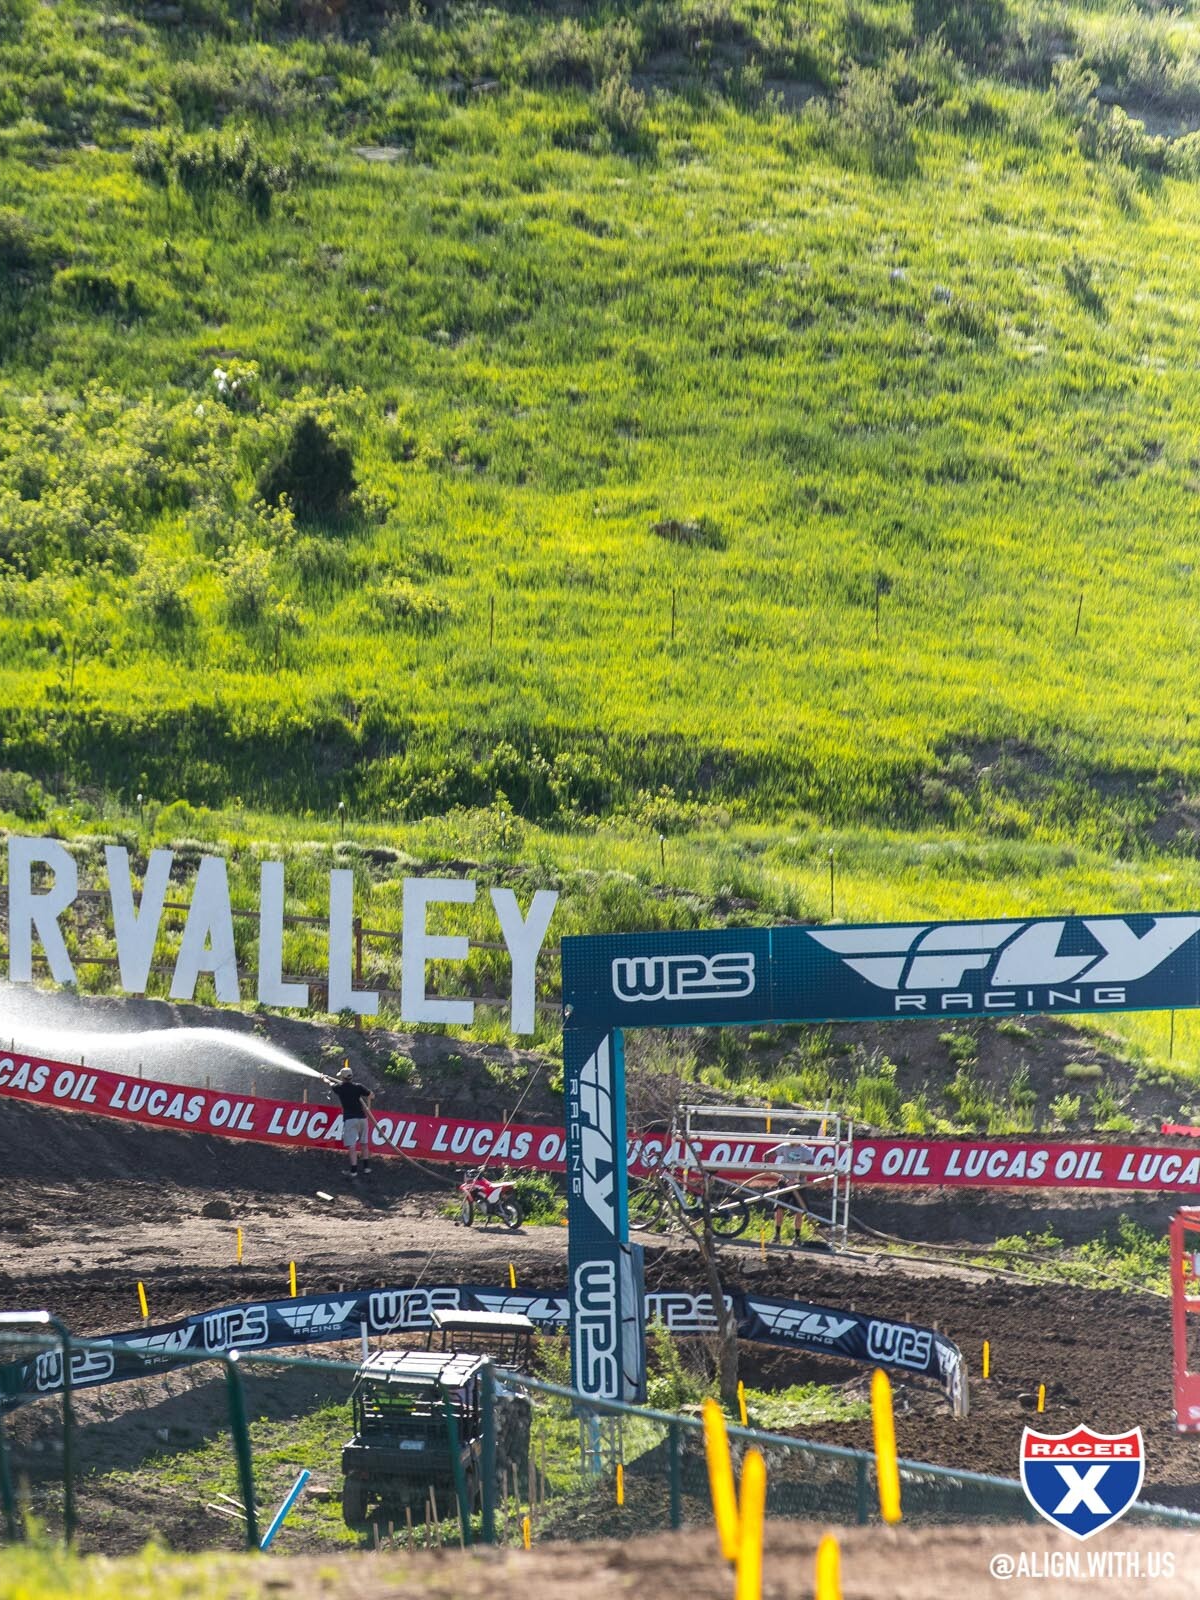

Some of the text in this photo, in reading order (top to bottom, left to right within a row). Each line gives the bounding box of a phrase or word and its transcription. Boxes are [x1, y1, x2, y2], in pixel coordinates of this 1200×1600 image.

[806, 917, 1200, 989] FLY
[612, 952, 755, 1002] WPS
[895, 987, 1127, 1011] RACING
[53, 1071, 98, 1103] OIL
[109, 1082, 255, 1130] LUCAS OIL
[267, 1107, 418, 1149] LUCA OIL
[432, 1124, 533, 1162] LUCAS
[569, 1078, 582, 1195] RACING
[580, 1033, 615, 1236] FLY
[881, 1147, 931, 1178] OIL
[944, 1149, 1104, 1181] LUCAS OIL
[1117, 1153, 1200, 1185] LUCA
[203, 1305, 268, 1351] WPS
[276, 1300, 358, 1328] FLY
[293, 1323, 342, 1335] RACING
[369, 1288, 460, 1331] WPS
[574, 1260, 618, 1399] WPS
[748, 1302, 859, 1339] FLY
[769, 1328, 835, 1346] RACING
[867, 1320, 934, 1370] WPS
